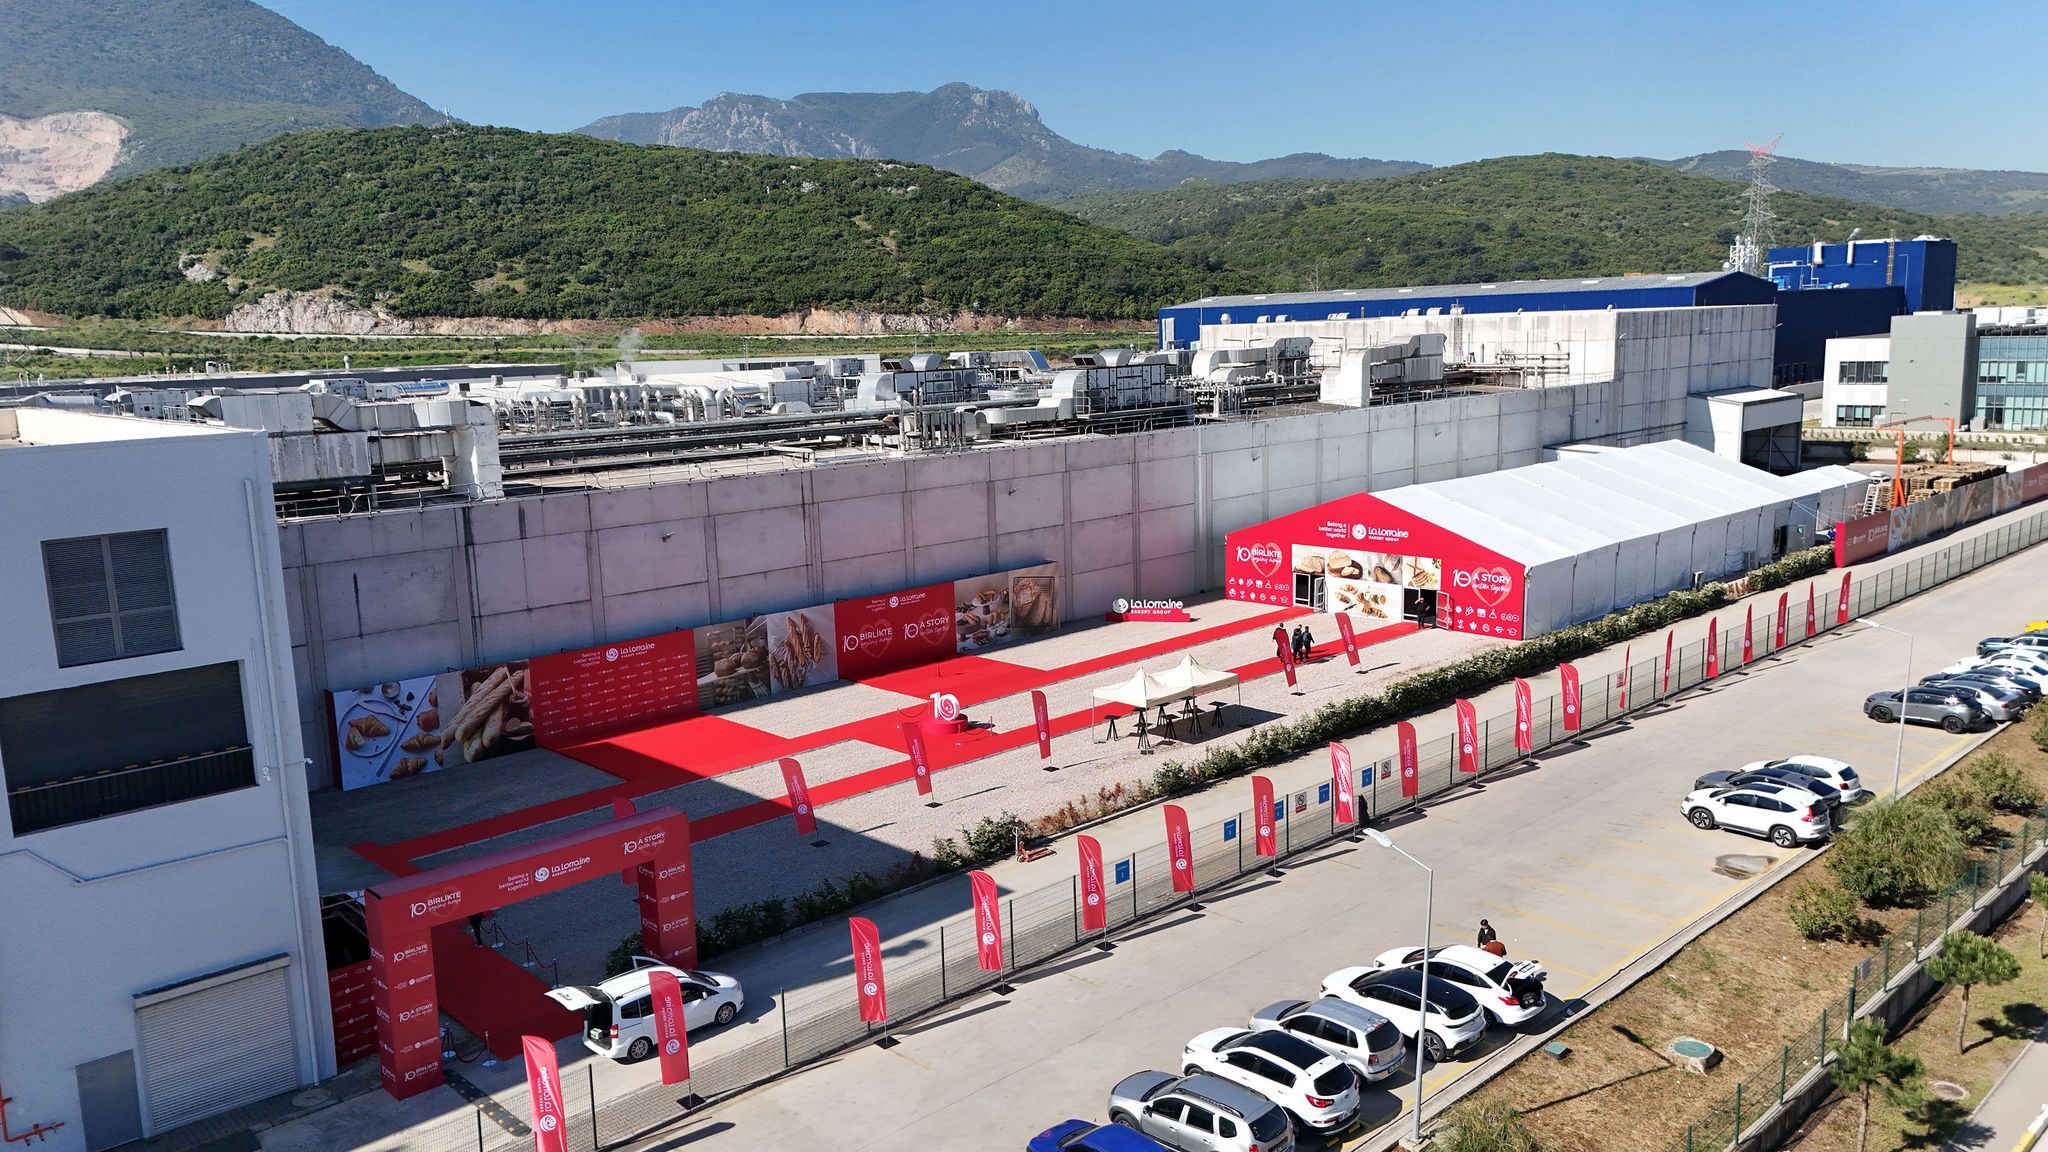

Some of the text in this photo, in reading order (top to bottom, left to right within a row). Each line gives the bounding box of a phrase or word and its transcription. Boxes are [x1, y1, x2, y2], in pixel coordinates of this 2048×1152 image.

[1368, 527, 1409, 538] La Lorraine
[1235, 546, 1251, 562] 10
[1453, 569, 1472, 587] 10
[1472, 573, 1512, 584] A STORY
[1130, 598, 1184, 609] La Lorraine
[926, 616, 950, 628] STORY
[860, 627, 893, 641] BİRLİKTE
[903, 624, 919, 640] 10
[630, 642, 656, 653] Lorraine
[842, 635, 858, 652] 10
[644, 832, 666, 843] STORY
[624, 841, 637, 856] 10
[560, 856, 590, 870] Lorraine
[427, 890, 462, 906] BİRLİKTE
[410, 902, 426, 918] 10
